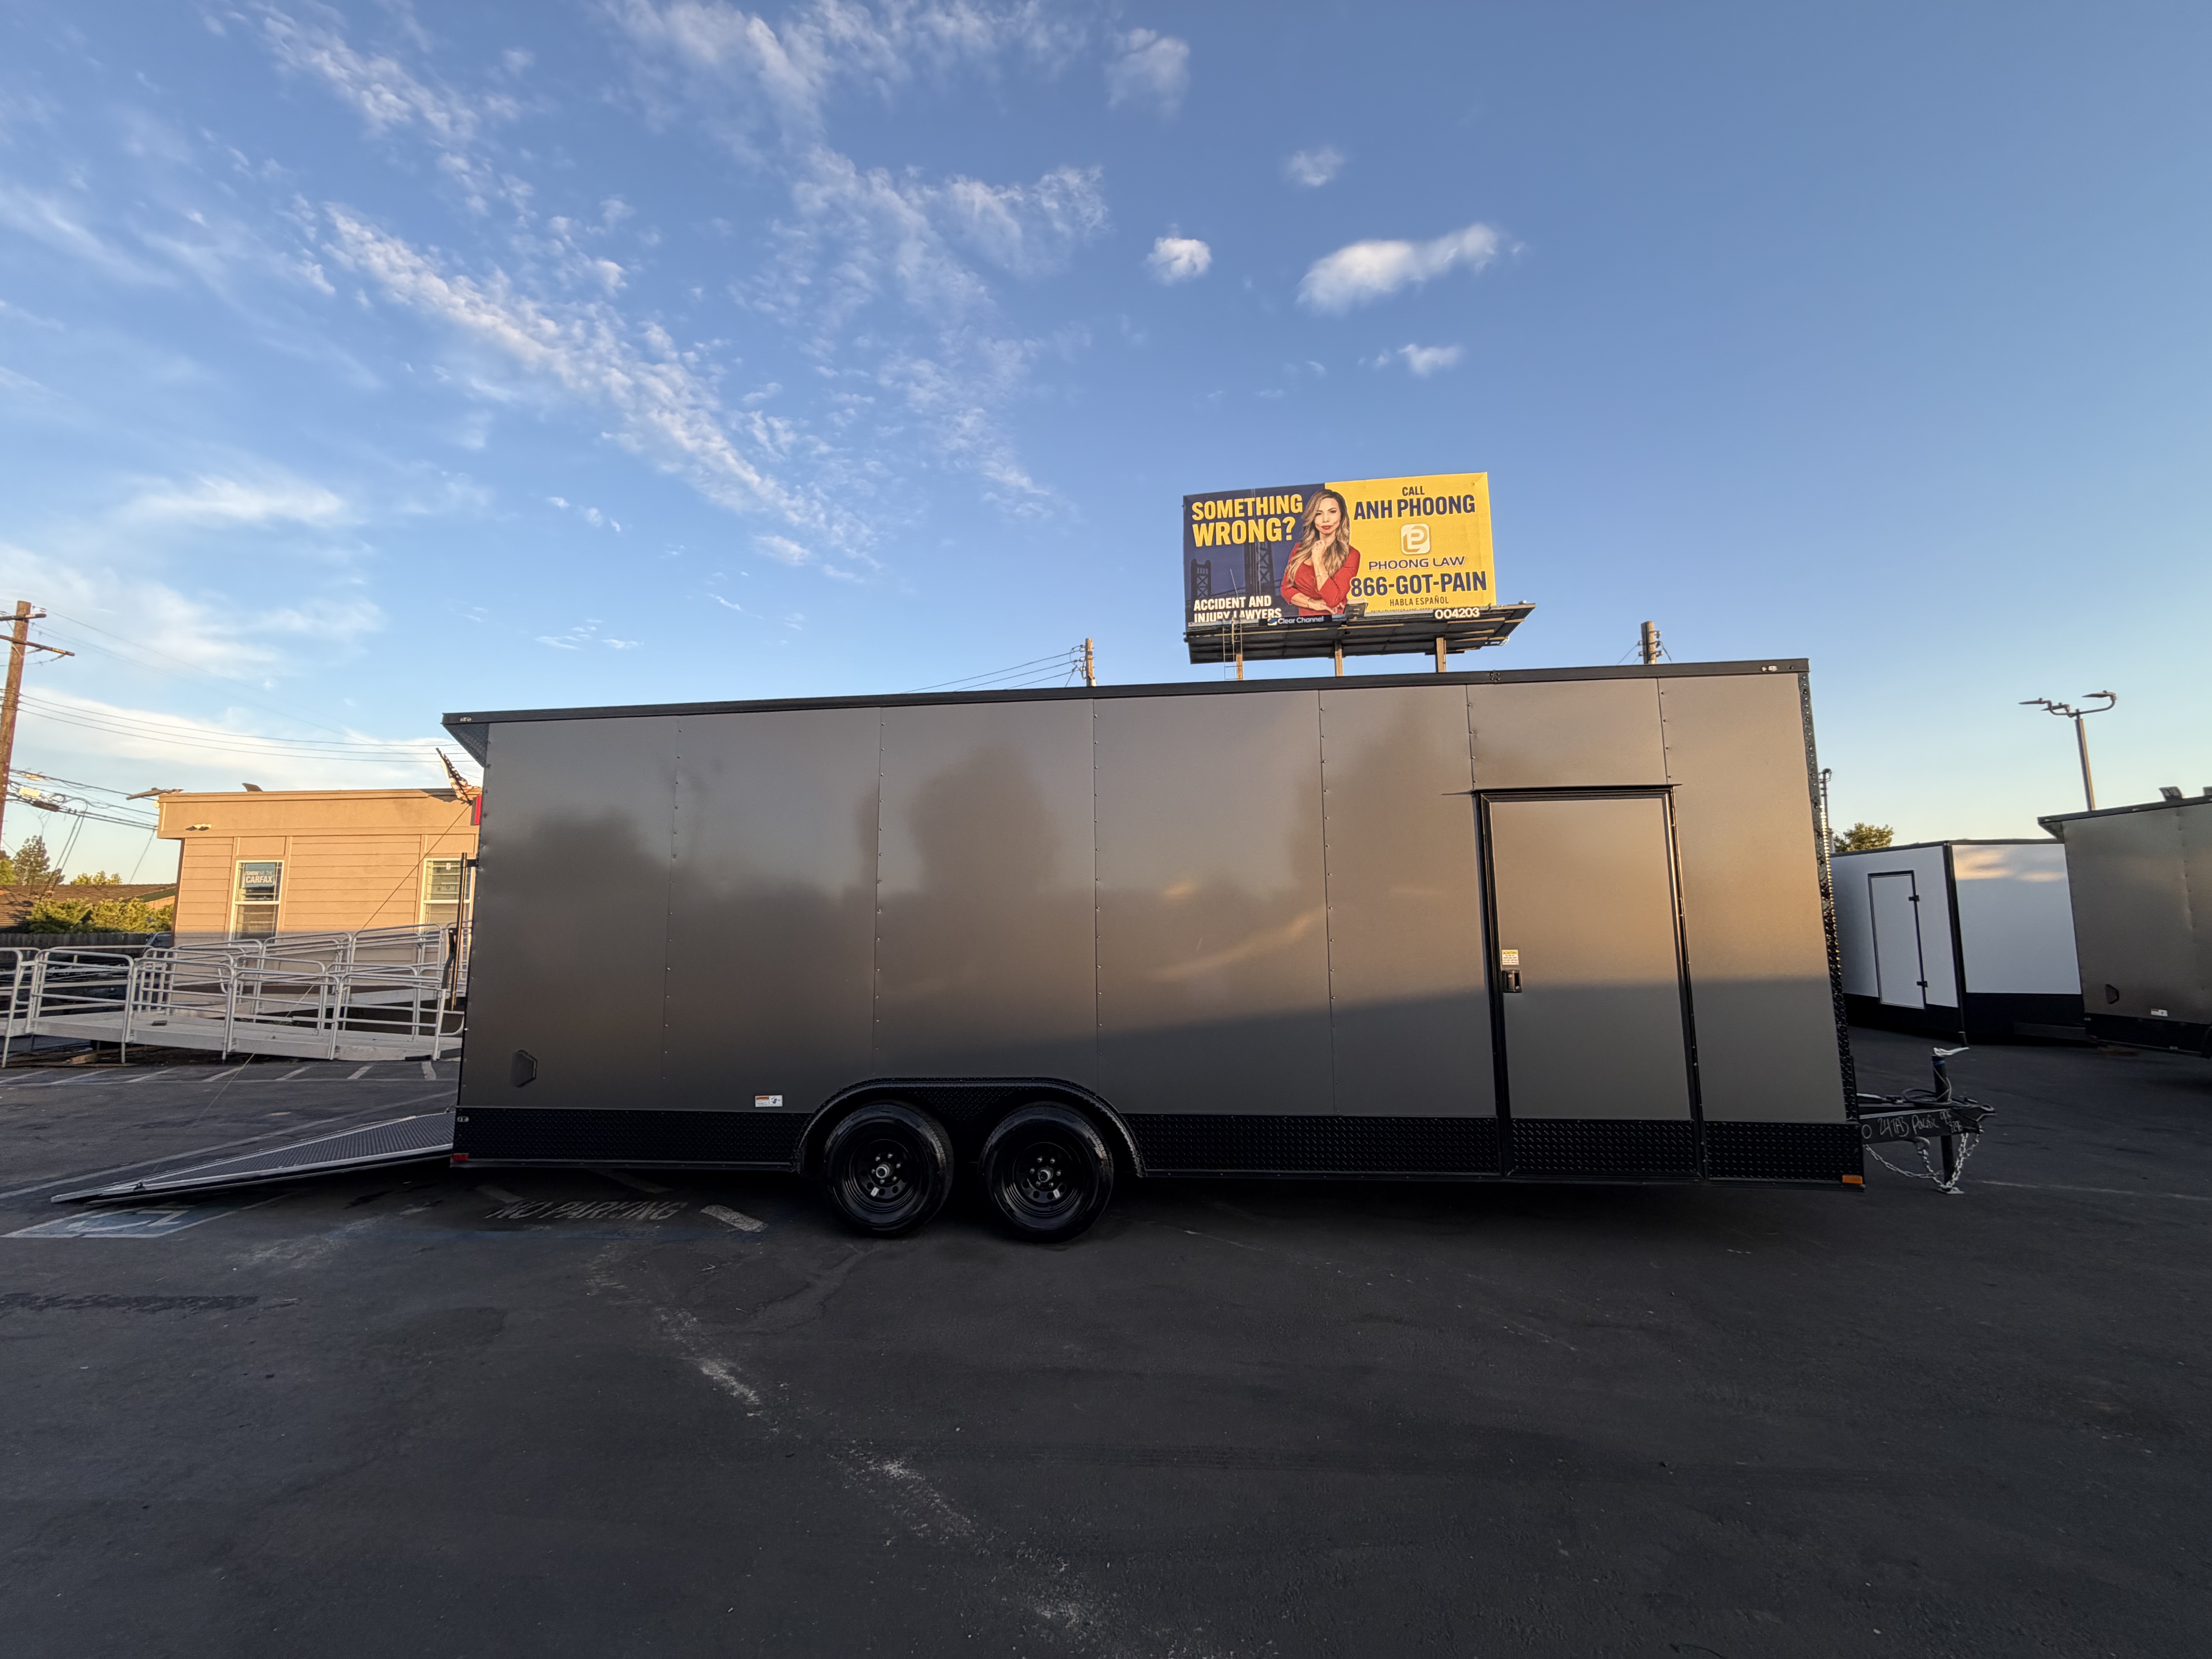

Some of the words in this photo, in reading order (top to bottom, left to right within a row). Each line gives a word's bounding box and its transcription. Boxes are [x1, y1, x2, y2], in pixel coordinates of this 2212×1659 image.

[1402, 486, 1425, 496] CALL
[1192, 494, 1303, 520] SOMETHING
[1353, 500, 1392, 520] ANH
[1397, 494, 1475, 517] PHOONG
[1192, 517, 1295, 547] WRONG?
[1369, 558, 1429, 570] PHOONG
[1433, 556, 1465, 567] LAW
[1351, 571, 1487, 597] 866-GOT-PAIN
[1194, 597, 1246, 611] ACCIDENT
[1249, 595, 1271, 608] AND
[1390, 598, 1413, 606] HABLA
[1416, 595, 1449, 605] ESPAÑOL
[1434, 607, 1480, 620] 004203
[538, 1201, 689, 1221] PARKING
